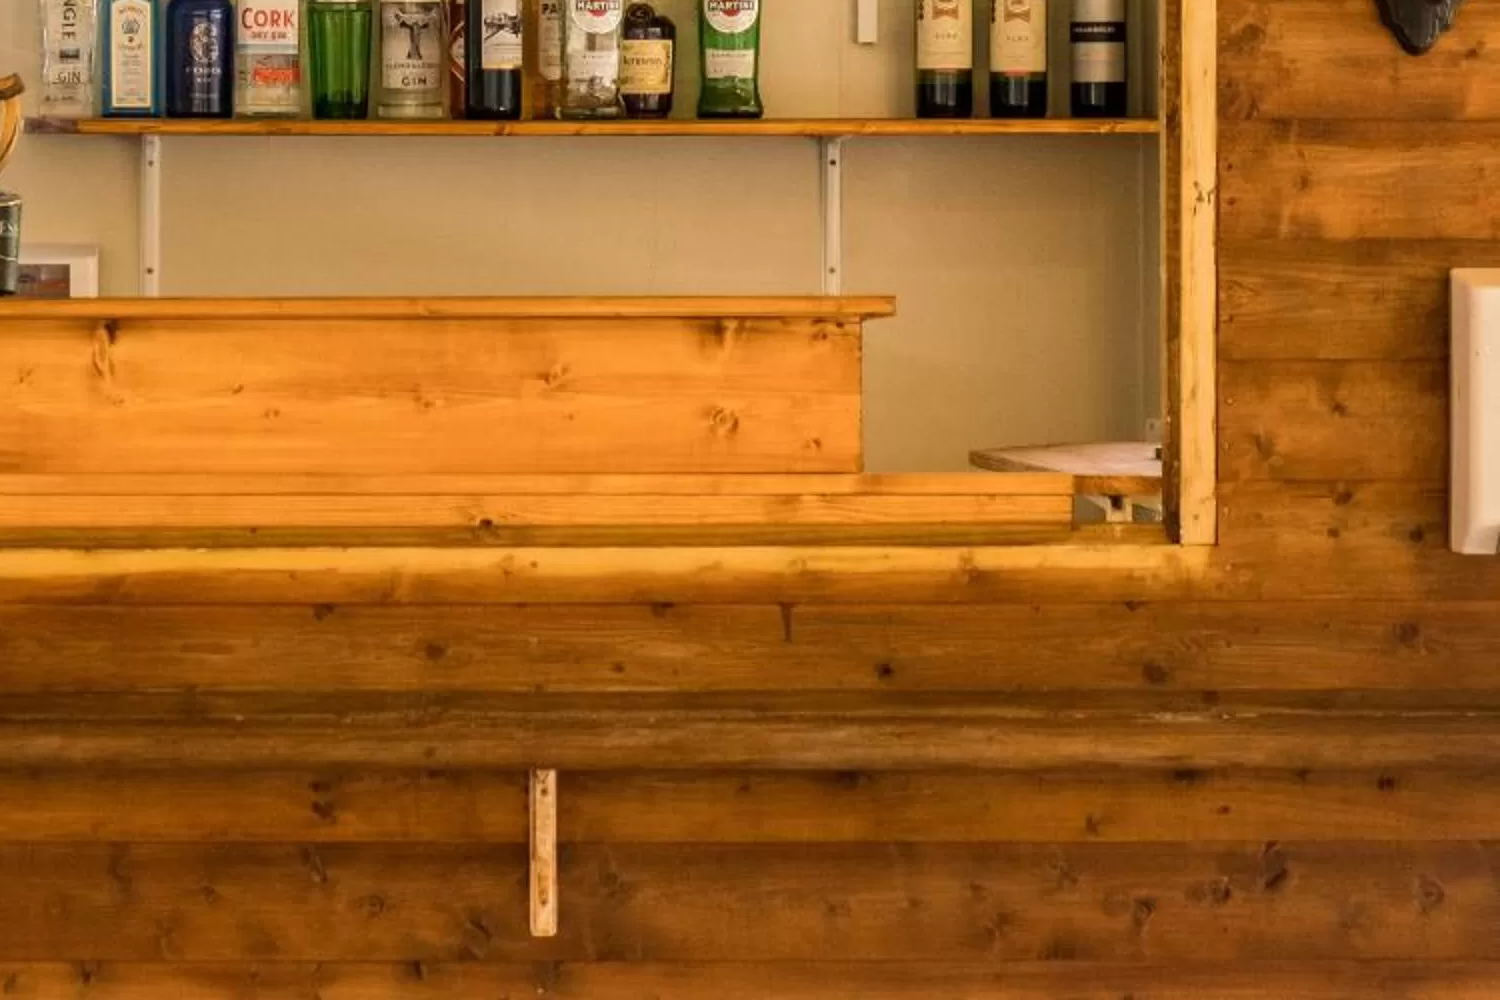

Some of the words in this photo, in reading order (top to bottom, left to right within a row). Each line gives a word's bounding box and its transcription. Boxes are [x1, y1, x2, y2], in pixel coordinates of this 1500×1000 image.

[574, 0, 620, 12] MARTINI
[708, 0, 756, 12] MARTINI
[241, 7, 296, 29] CORK
[251, 30, 269, 40] DRY
[58, 70, 81, 86] GIN
[401, 75, 427, 87] GIN
